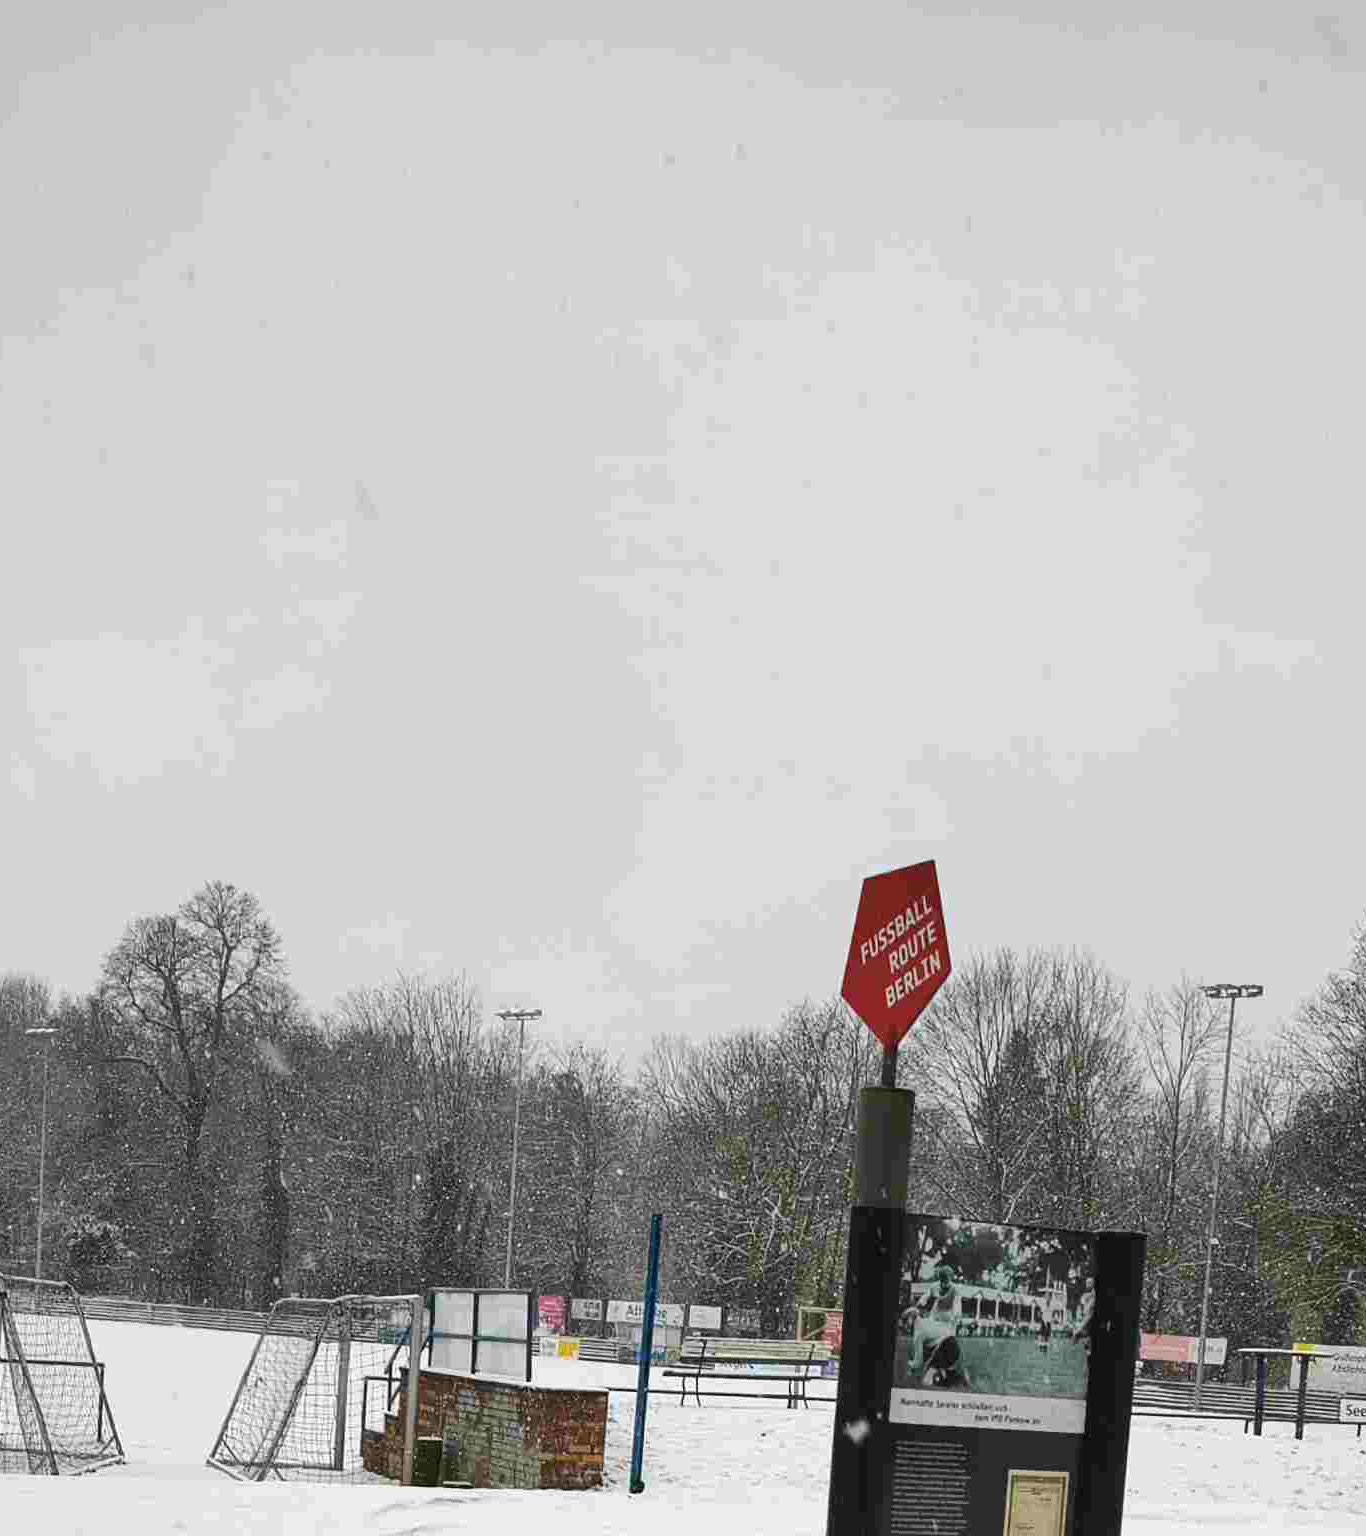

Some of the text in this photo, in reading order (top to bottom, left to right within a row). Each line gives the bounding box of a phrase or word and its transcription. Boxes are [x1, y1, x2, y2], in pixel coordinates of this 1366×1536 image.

[859, 895, 934, 965] FUSSBALL
[888, 921, 938, 974] ROUTE
[885, 950, 942, 1009] BERLIN
